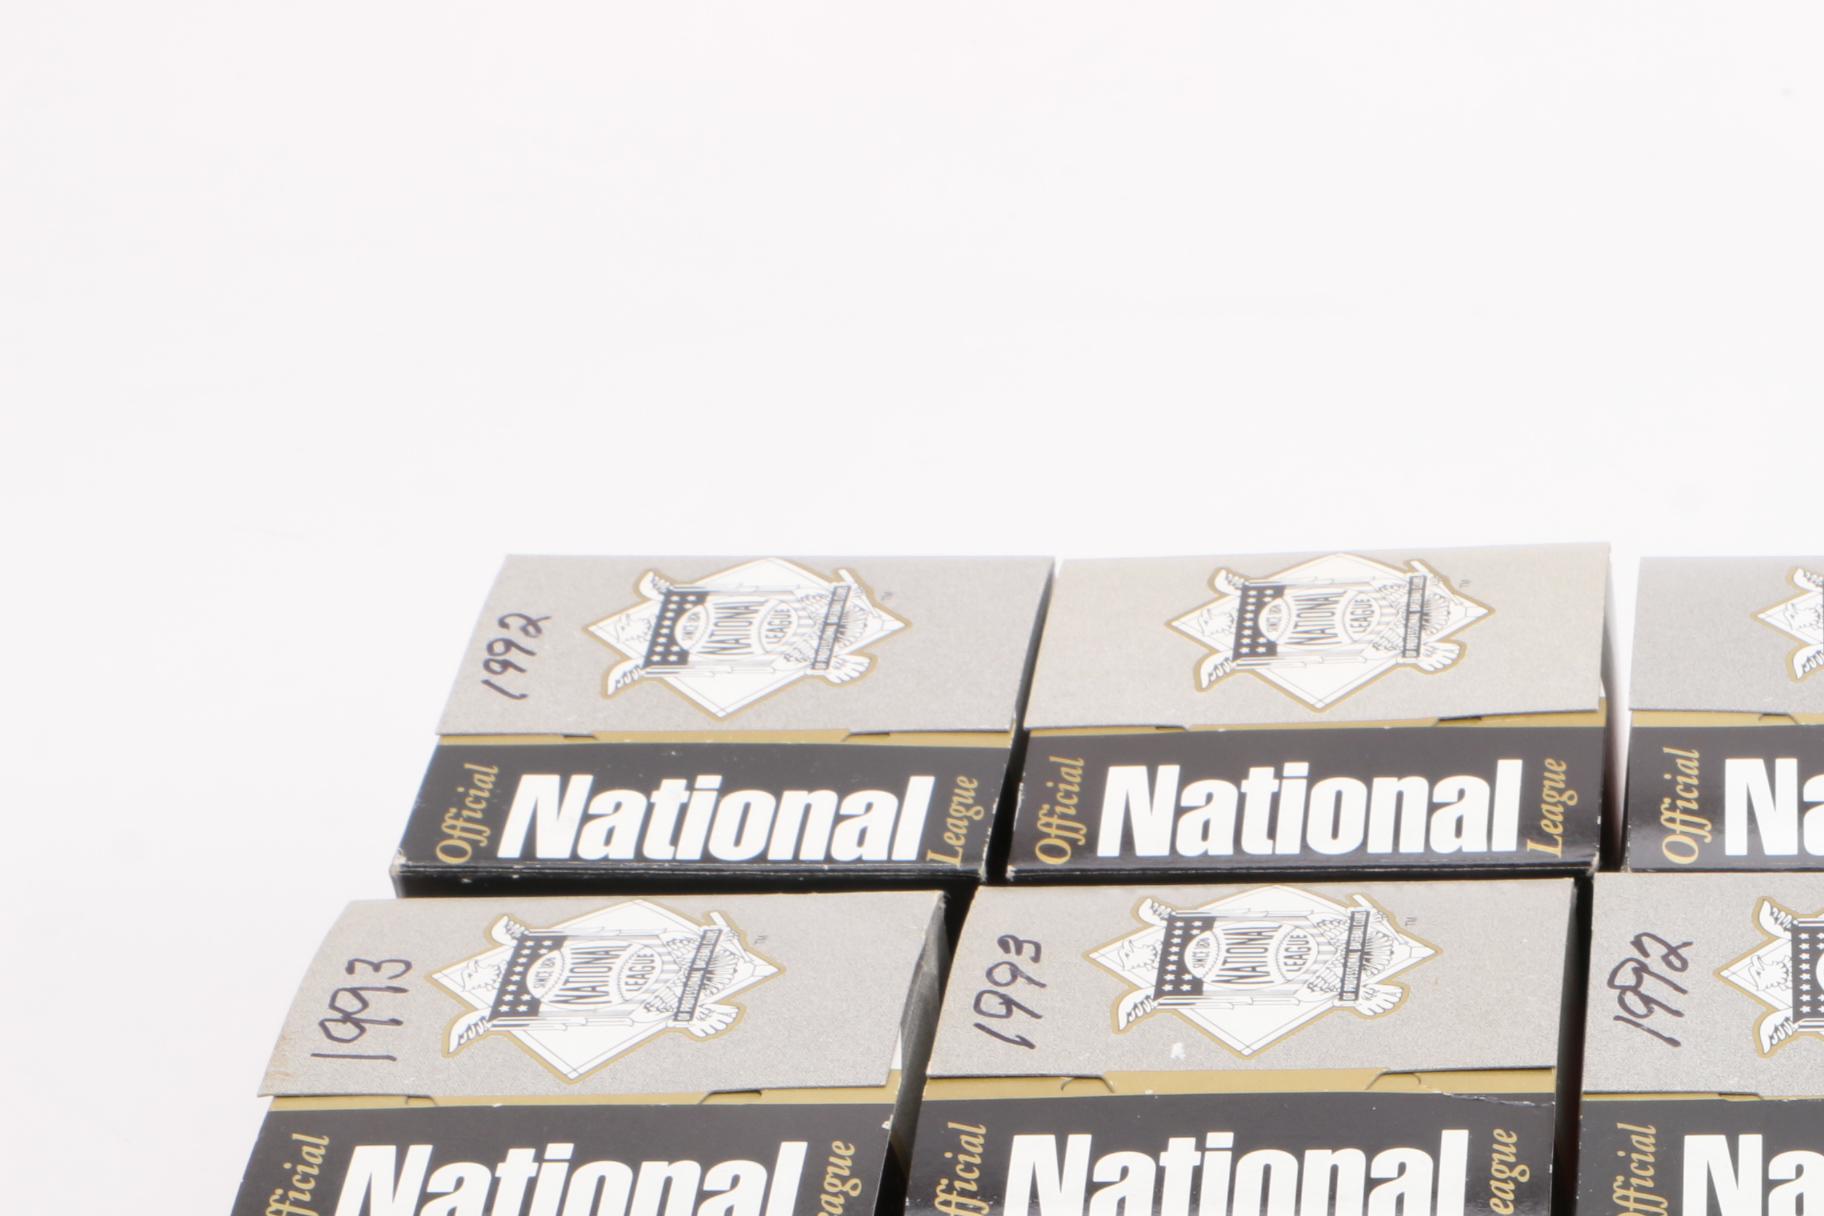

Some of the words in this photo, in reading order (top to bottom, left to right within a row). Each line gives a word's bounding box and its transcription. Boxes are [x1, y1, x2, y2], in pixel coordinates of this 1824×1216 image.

[482, 612, 551, 699] 1992
[435, 763, 499, 864] Official
[496, 773, 935, 861] National
[928, 775, 983, 867] League
[1035, 755, 1085, 864] Official
[1096, 759, 1523, 857] National
[1528, 757, 1568, 858] League
[1661, 747, 1711, 864] Official
[550, 944, 632, 1004] NATIONAL
[625, 952, 655, 992] LEAGUE
[974, 934, 1042, 1050] 1993
[1212, 925, 1282, 984] NATIONAL
[1284, 935, 1311, 972] LEAGUE
[1607, 931, 1693, 1048] 1992
[311, 958, 412, 1061] 1993
